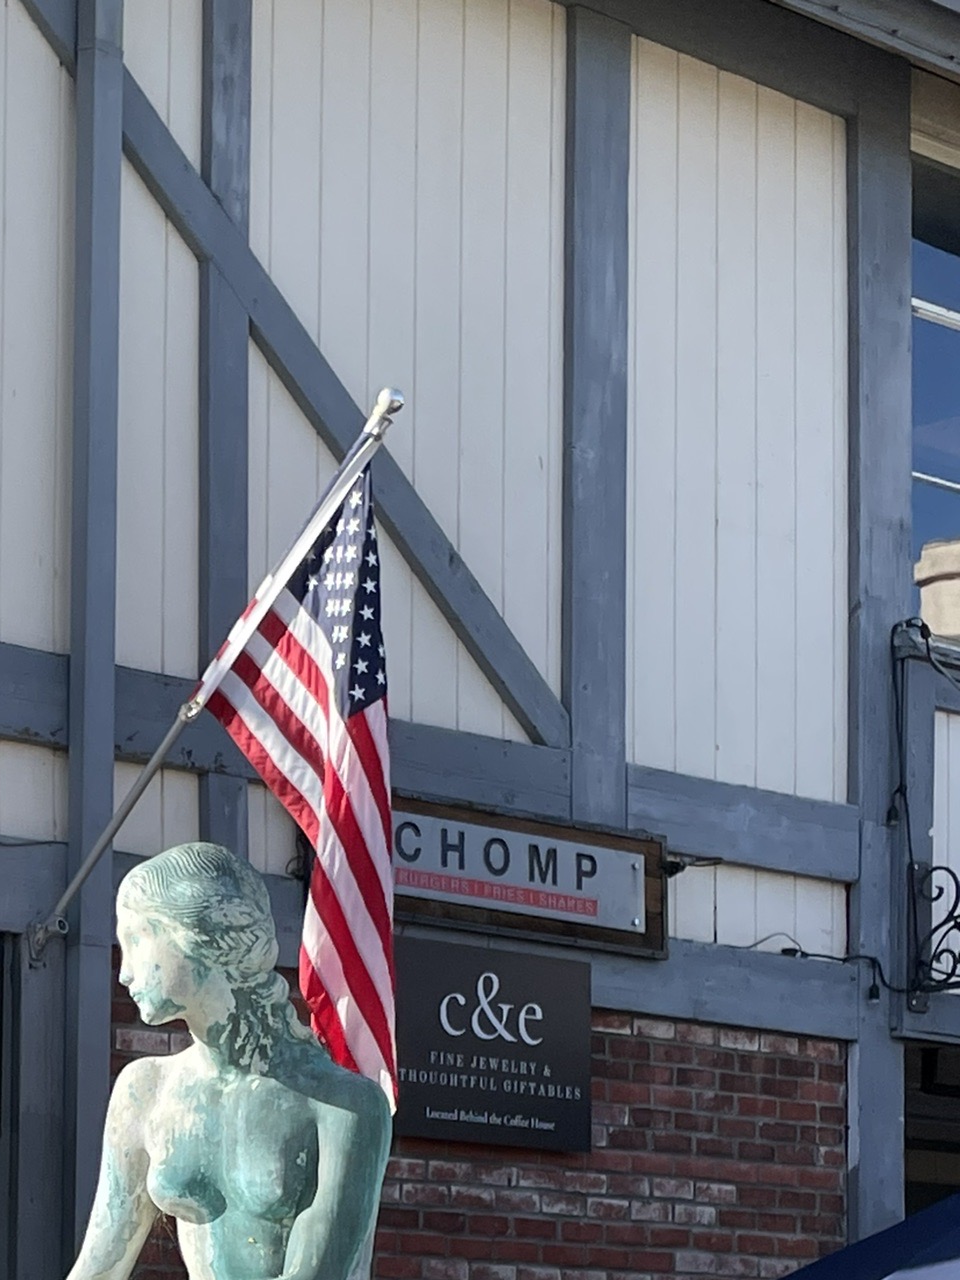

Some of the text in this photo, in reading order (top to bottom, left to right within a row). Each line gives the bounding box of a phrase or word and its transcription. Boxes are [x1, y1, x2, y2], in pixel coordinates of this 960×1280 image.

[394, 821, 598, 891] CHOMP
[483, 882, 529, 902] FRIES
[440, 972, 544, 1047] c&e
[429, 1051, 552, 1077] FINE JEWELRY &
[399, 1067, 582, 1101] THOUGHTFUL GIFTABLES
[489, 1113, 502, 1125] the
